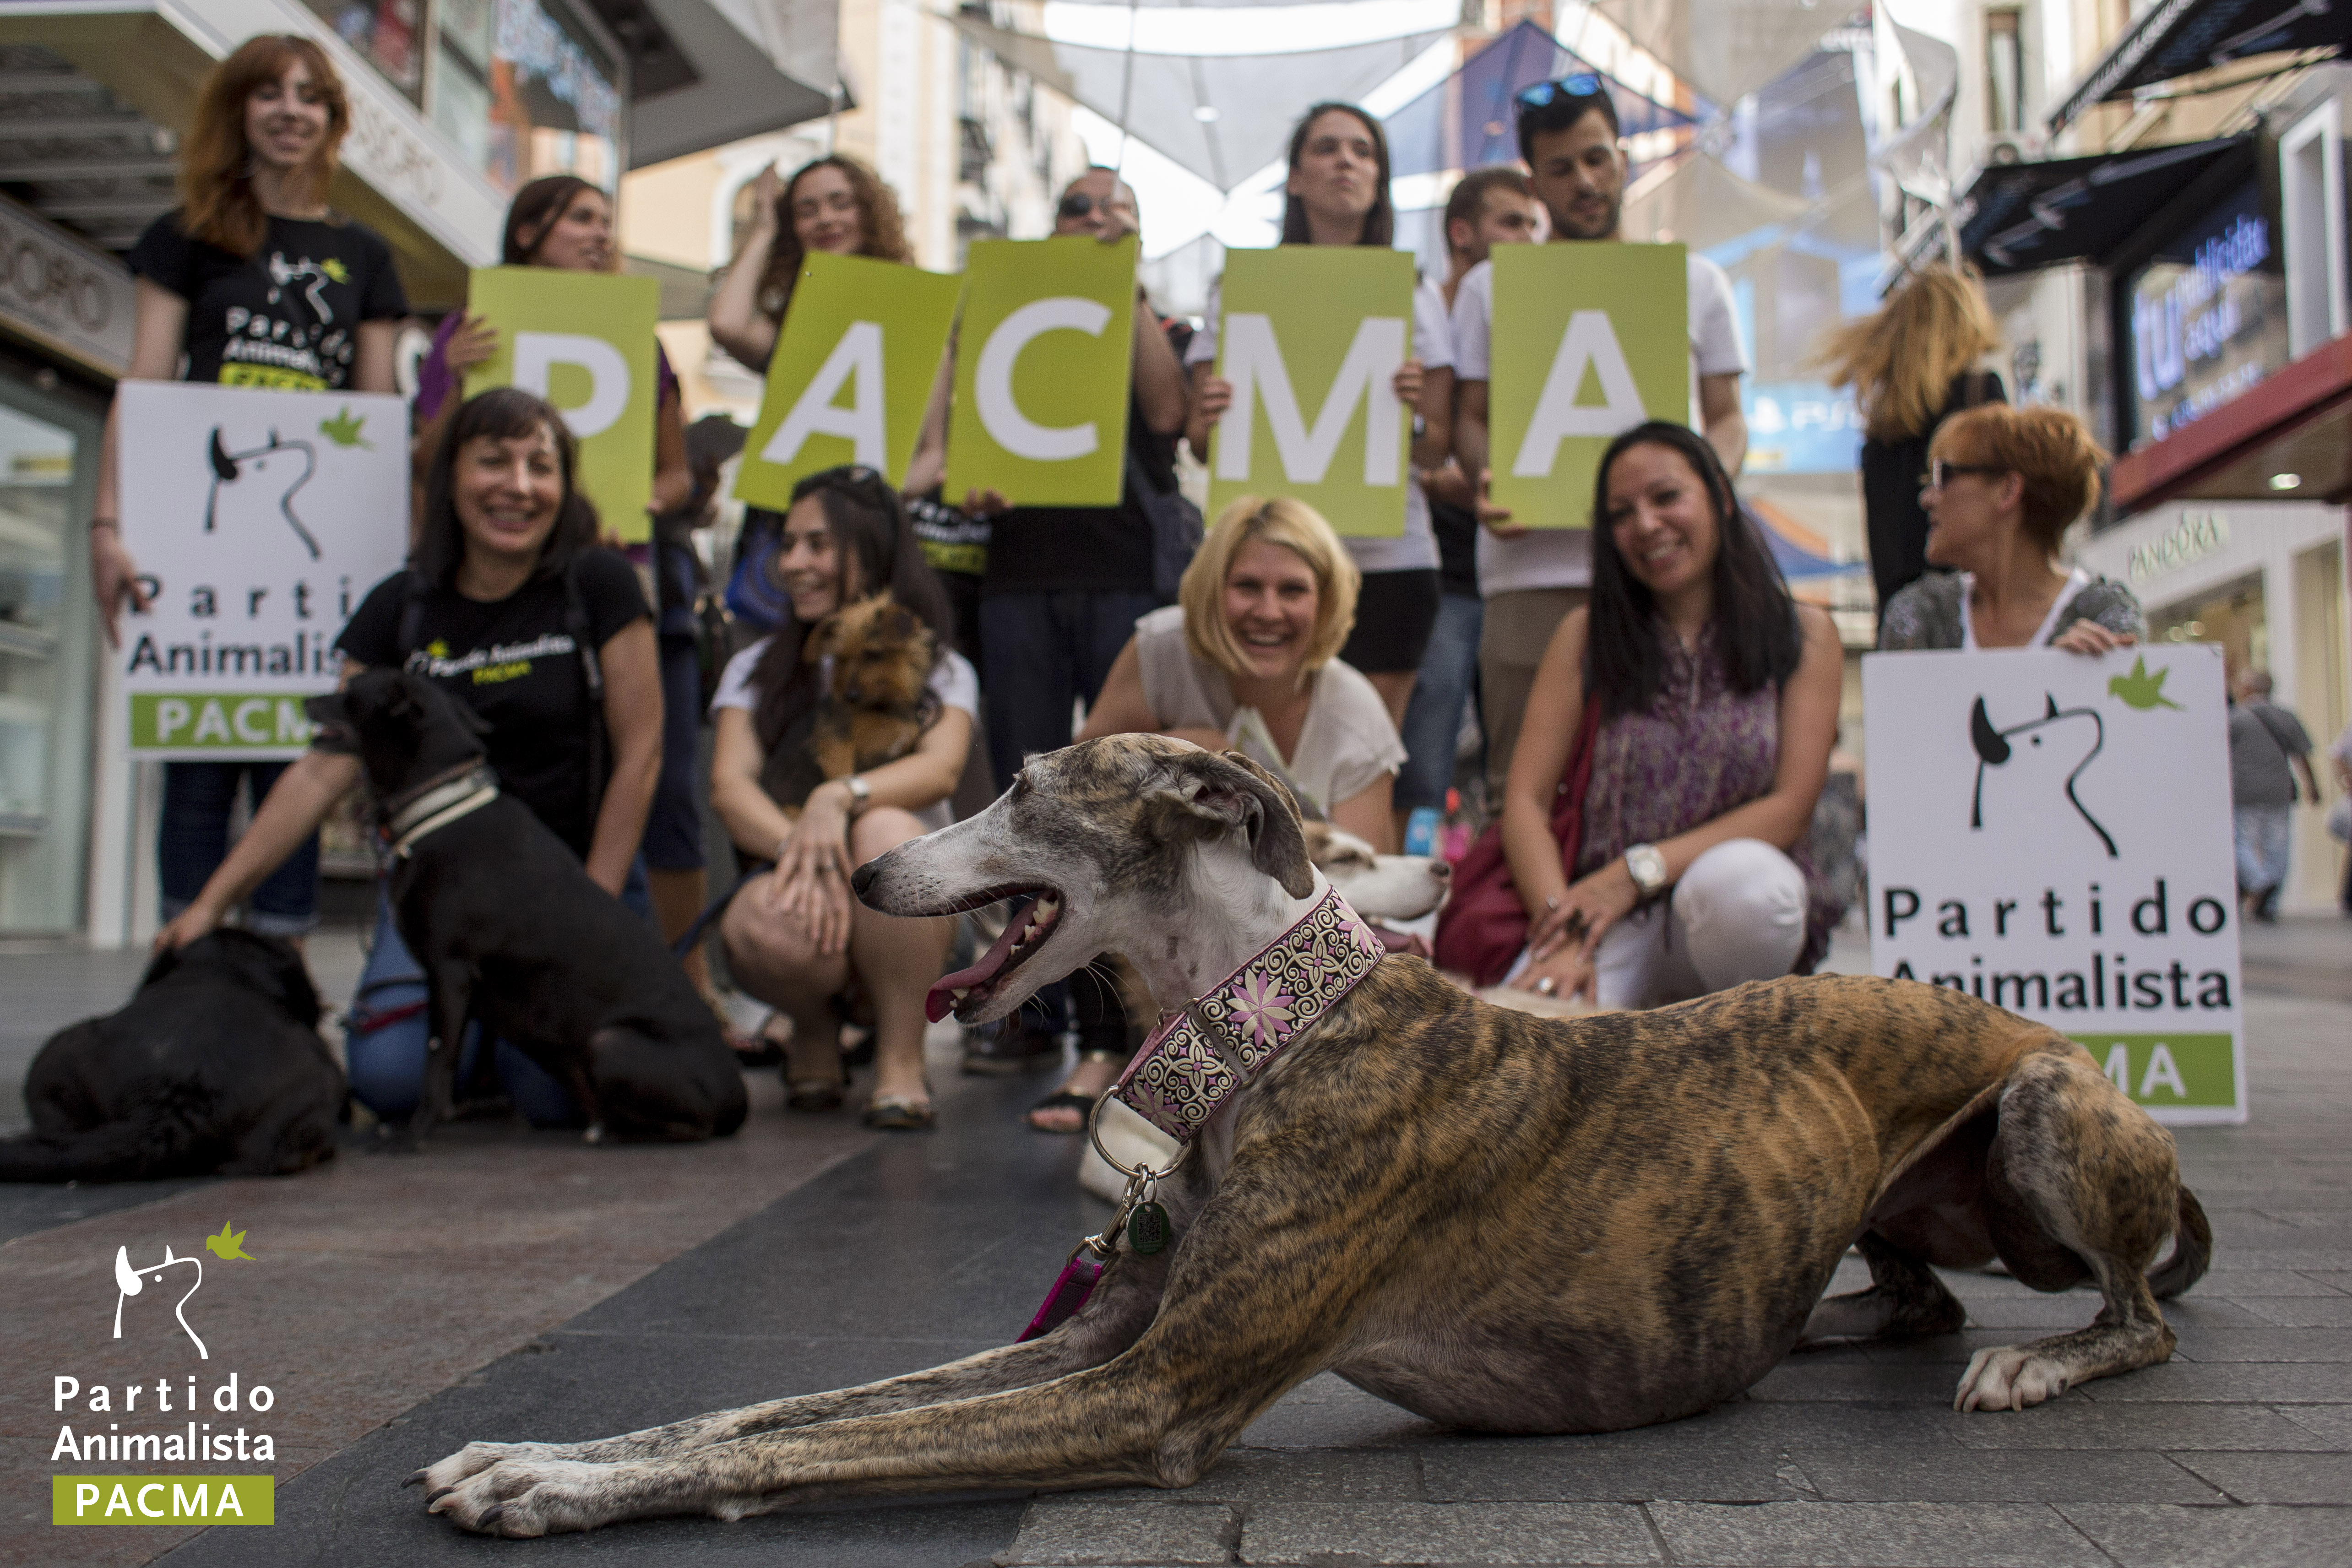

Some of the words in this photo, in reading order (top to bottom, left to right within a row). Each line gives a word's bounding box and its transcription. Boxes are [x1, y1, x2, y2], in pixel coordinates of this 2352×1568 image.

[2127, 509, 2221, 578] PANDORA
[130, 572, 352, 617] Parti
[127, 630, 349, 676] Animalis
[155, 697, 314, 743] PACM
[1883, 875, 2227, 939] Partido
